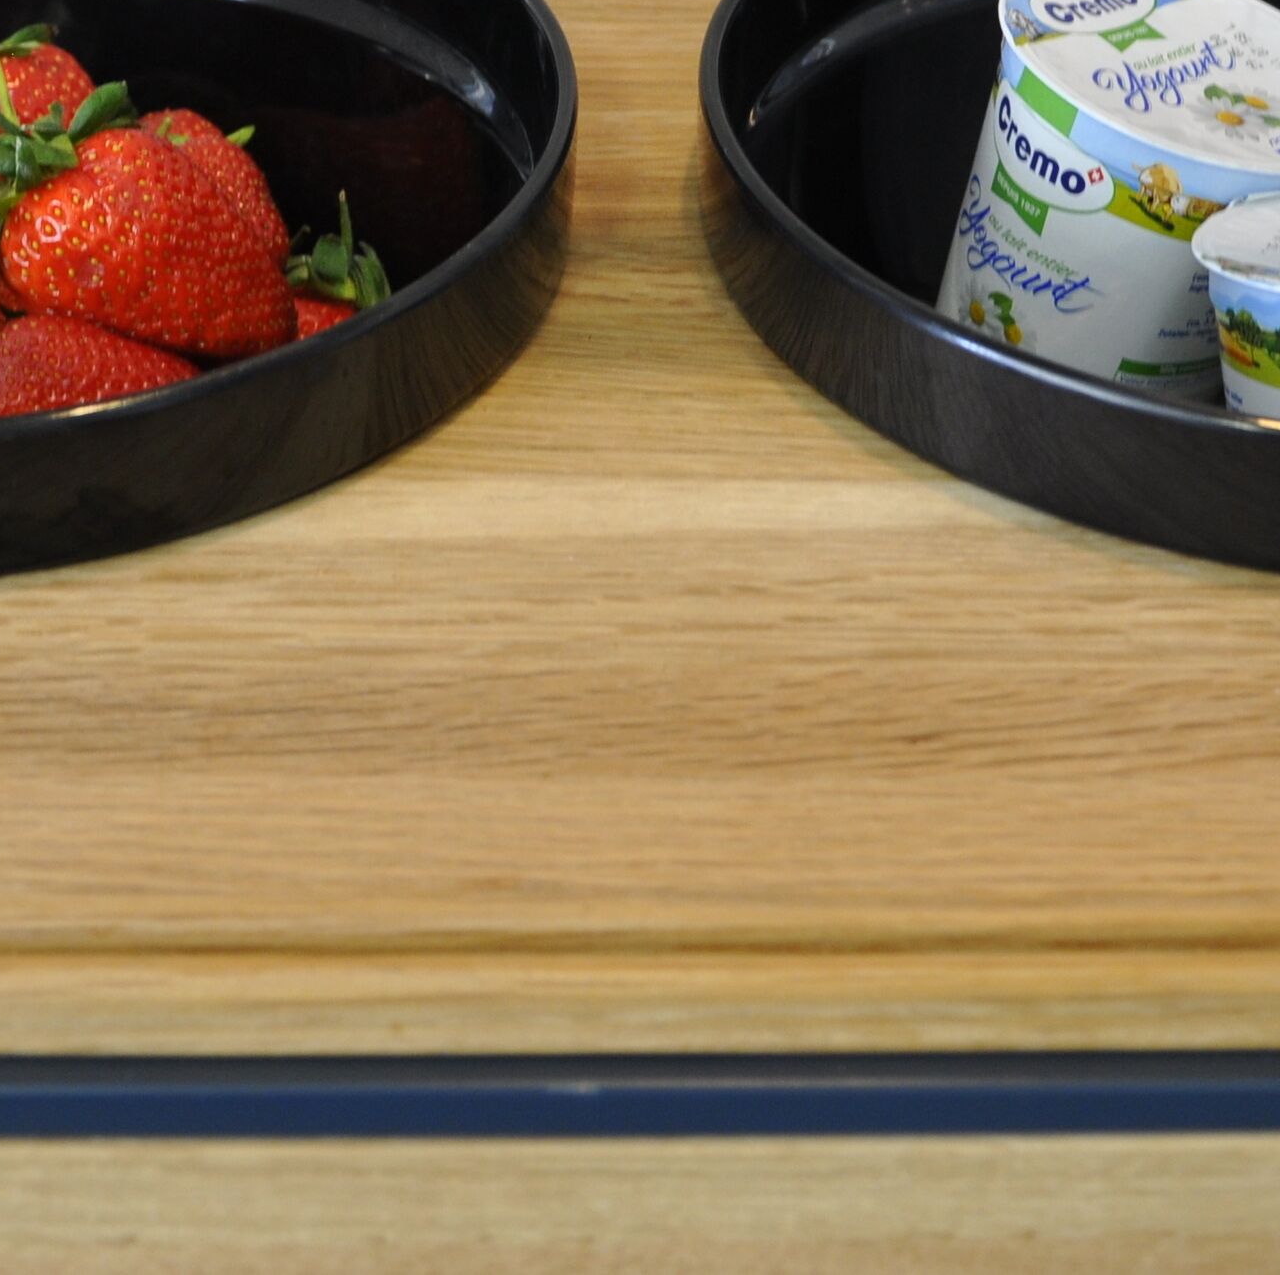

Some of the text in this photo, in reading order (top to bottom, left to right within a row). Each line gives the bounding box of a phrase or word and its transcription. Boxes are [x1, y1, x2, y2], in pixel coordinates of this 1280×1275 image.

[1092, 39, 1237, 113] Yogourt
[1167, 43, 1198, 62] entier
[998, 93, 1087, 195] Cremo
[1020, 192, 1042, 219] 1927
[959, 174, 1106, 313] Yogourt
[1026, 248, 1080, 277] entier
